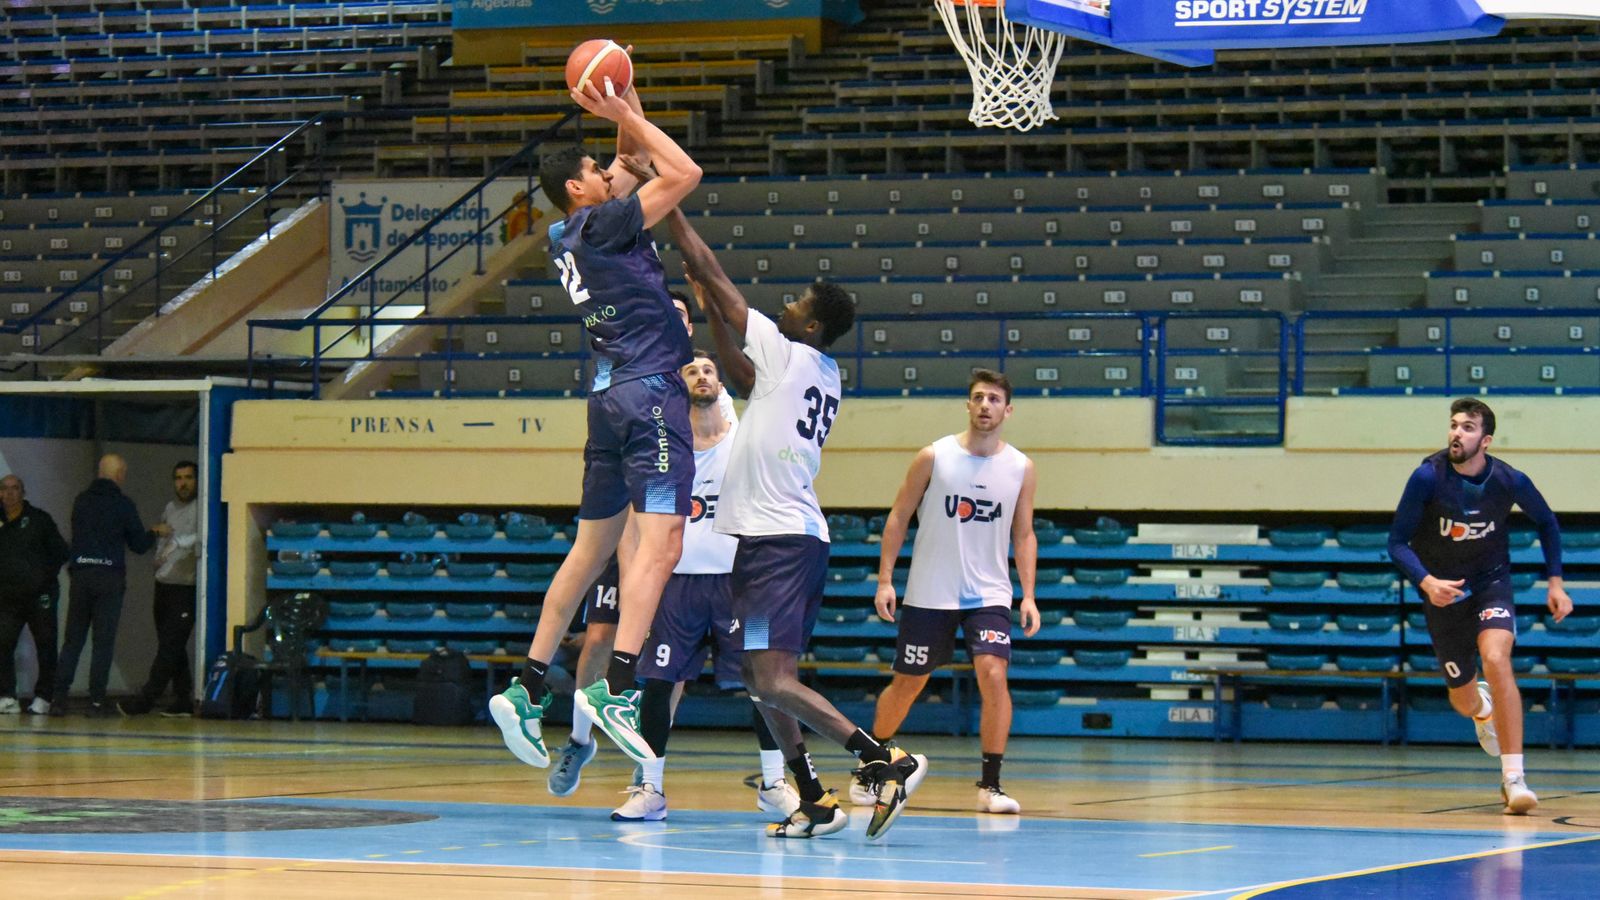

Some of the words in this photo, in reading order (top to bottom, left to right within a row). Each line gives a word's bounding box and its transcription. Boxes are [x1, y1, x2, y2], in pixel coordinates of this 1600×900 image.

[1175, 0, 1261, 19] SPORT
[1262, 0, 1368, 24] SYSTEM
[387, 229, 409, 246] de
[554, 251, 591, 305] 22
[351, 416, 435, 433] PRENSA
[517, 417, 546, 434] TV
[796, 386, 839, 448] 35
[650, 406, 669, 473] damex.io
[944, 494, 1002, 523] UDEA
[1439, 516, 1496, 542] UDEA
[1174, 543, 1204, 558] FILA
[595, 584, 618, 610] 14
[1177, 583, 1206, 597] FILA
[1209, 583, 1219, 596] 4
[979, 629, 1011, 645] UDEA
[1175, 625, 1205, 639] FILA
[655, 643, 671, 668] 9
[904, 643, 929, 666] 55
[1170, 708, 1201, 721] FILA
[1205, 708, 1214, 721] 1
